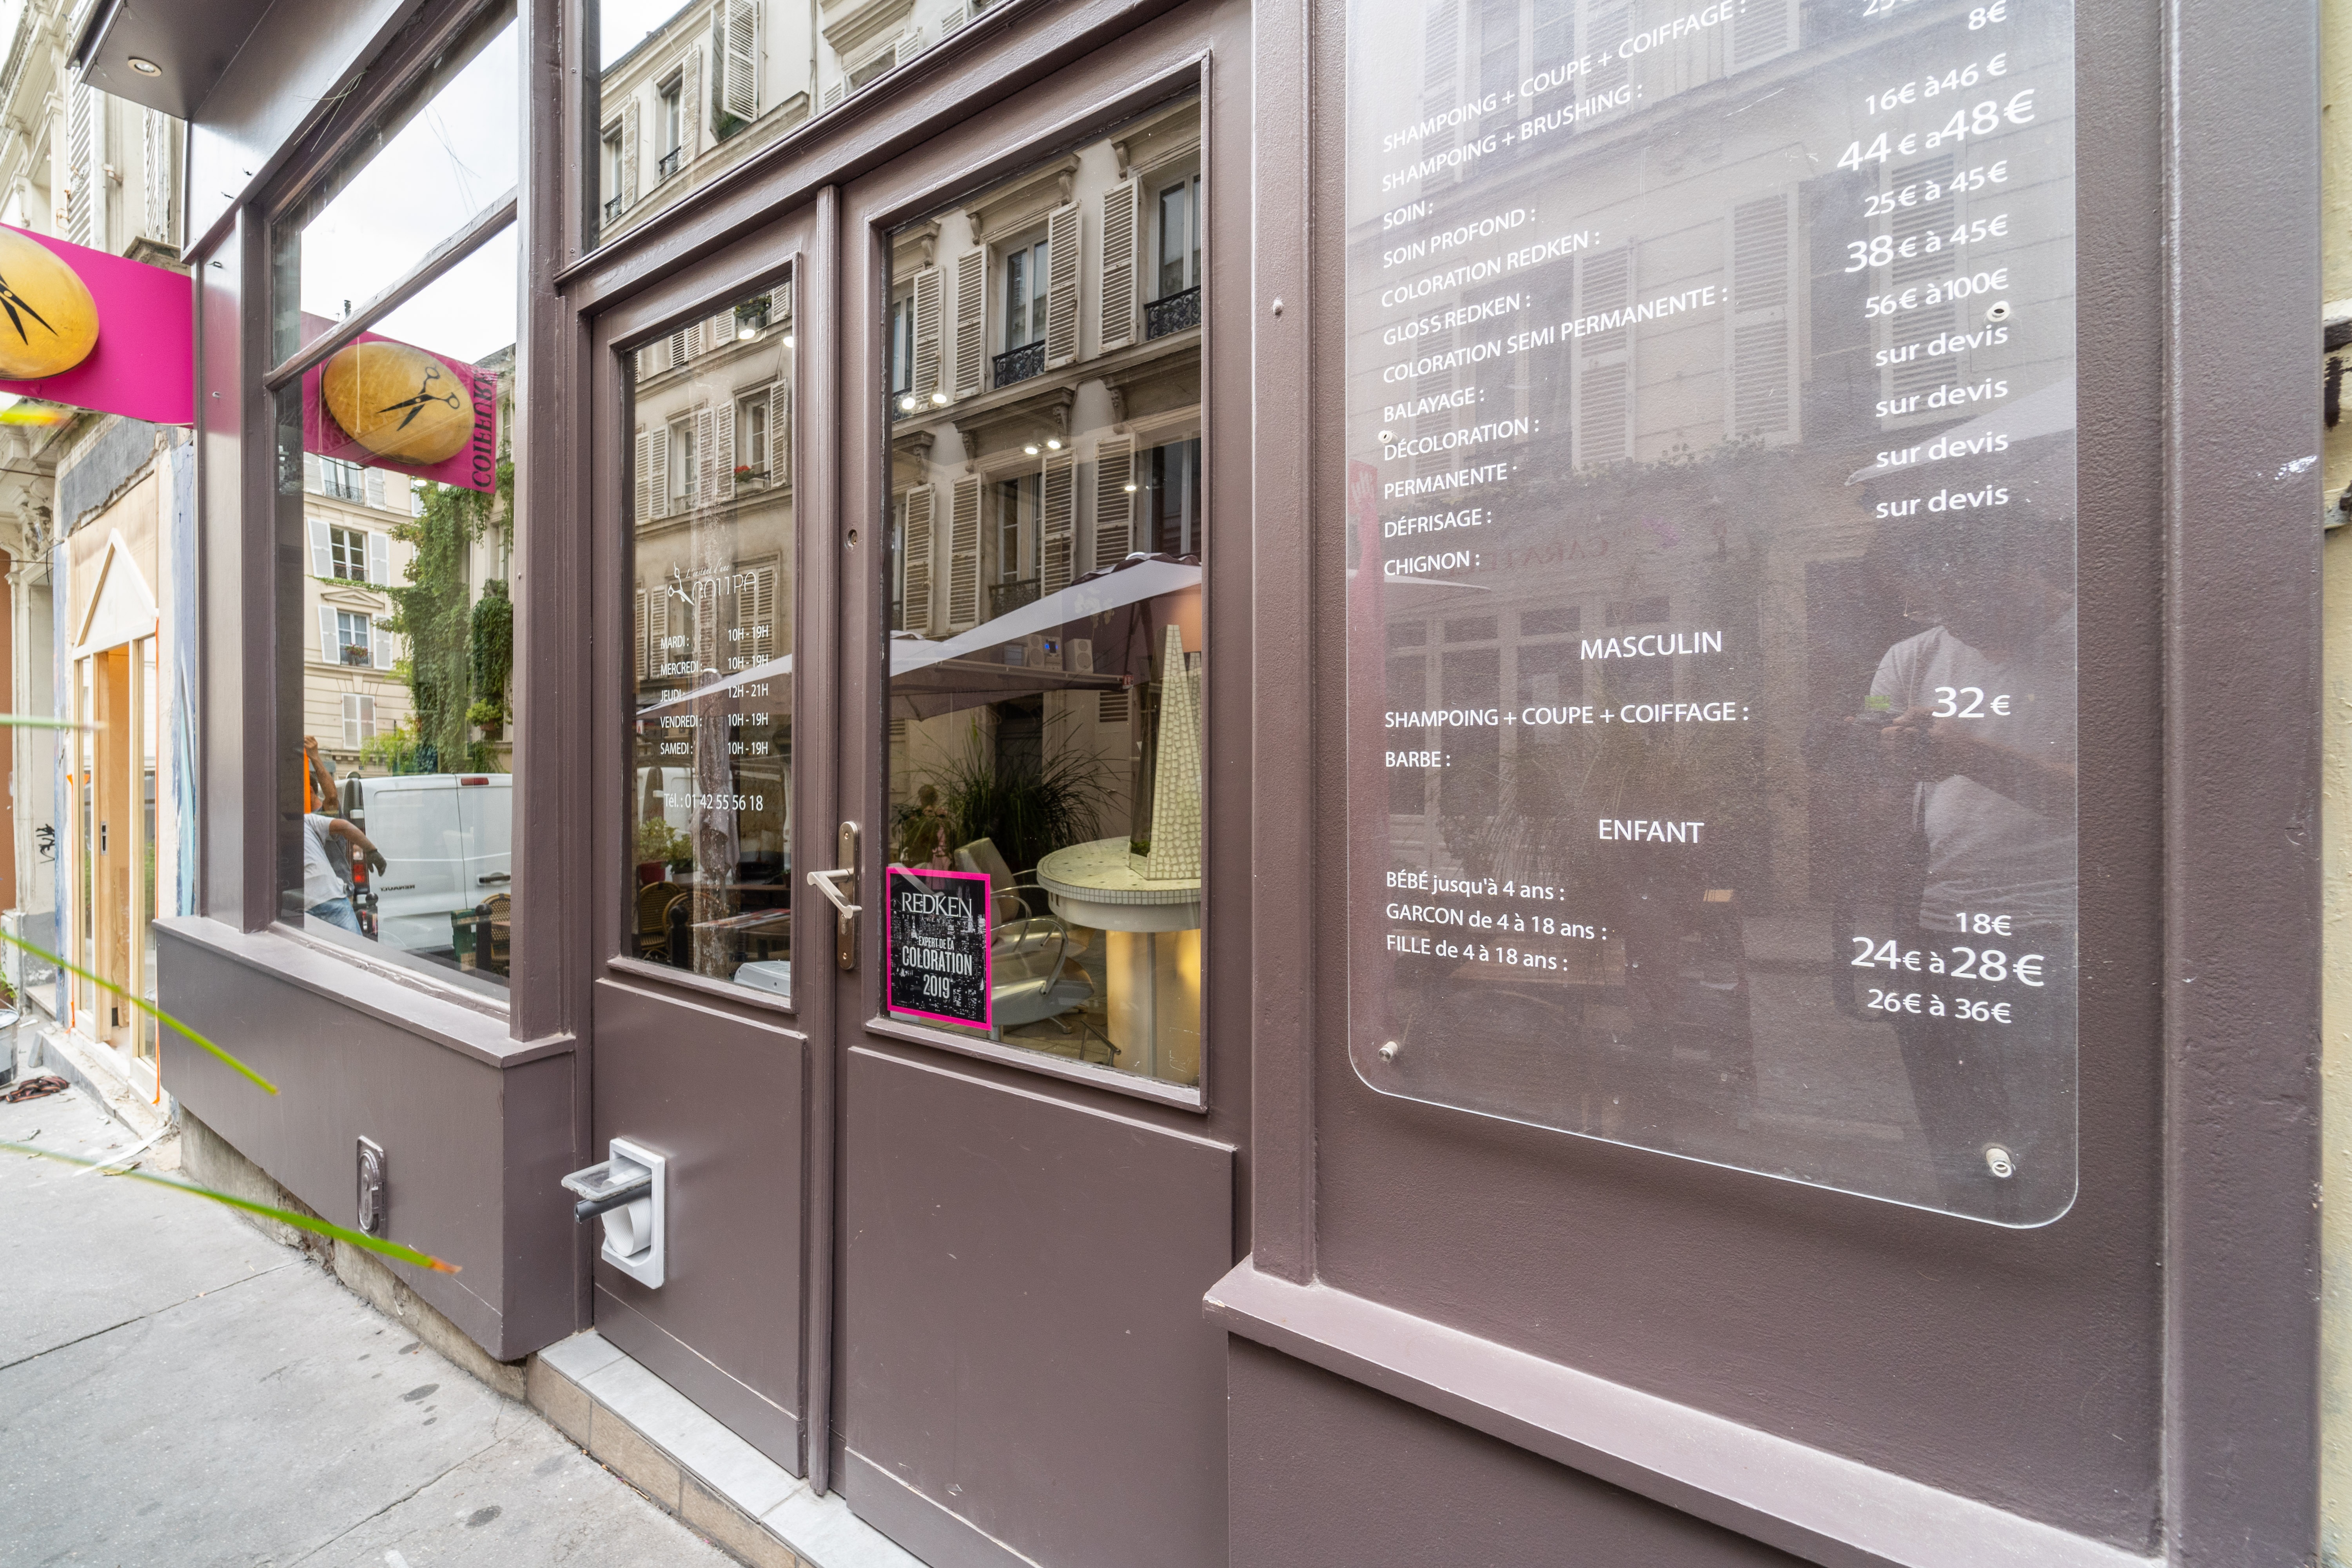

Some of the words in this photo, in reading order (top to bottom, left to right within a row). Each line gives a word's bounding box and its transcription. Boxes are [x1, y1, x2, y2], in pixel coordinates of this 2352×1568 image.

[1968, 0, 2007, 30] 8€
[1383, 93, 1496, 152] SHAMPOING
[1502, 91, 1515, 104] +
[1520, 54, 1592, 97] COUPE
[1597, 52, 1612, 67] +
[1619, 0, 1733, 58] COIFFAGE
[1382, 134, 1496, 192] SHAMPOING
[1501, 132, 1515, 146] +
[1521, 84, 1630, 141] BRUSHING
[1924, 180, 1940, 201] à
[1949, 160, 2008, 192] 45€
[1383, 200, 1425, 230] SOIN
[1383, 240, 1425, 268] SOIN
[1431, 209, 1525, 253] PROFOND
[1925, 230, 1941, 253] à
[1949, 214, 2008, 245] 45€
[1381, 257, 1501, 307] COLORATION
[1507, 230, 1588, 270] REDKEN
[1383, 315, 1441, 345] GLOSS
[1445, 293, 1520, 329] REDKEN
[1383, 339, 1501, 383] COLORATION
[1507, 326, 1554, 354] SEMI
[1561, 285, 1715, 341] PERMANENTE
[1875, 343, 1920, 367] sur
[1927, 325, 2008, 356] devis
[1384, 387, 1475, 422] BALAYAGE
[1875, 395, 1920, 417] sur
[1927, 378, 2008, 408] devis
[1385, 416, 1528, 461] DÉCOLORATION
[1876, 446, 1920, 468] sur
[1928, 431, 2008, 460] devis
[1385, 462, 1507, 499] PERMANENTE
[1875, 498, 1921, 519] sur
[1927, 484, 2010, 512] devis
[1385, 508, 1482, 538] DÉFRISAGE
[1384, 550, 1470, 575] CHIGNON
[661, 635, 685, 649] MARDI
[728, 627, 744, 642] 10H
[751, 625, 768, 639] 19H
[1581, 630, 1722, 660] MASCULIN
[661, 661, 699, 676] MERCREDI
[728, 656, 744, 670] 10H
[751, 654, 768, 668] 19H
[661, 689, 681, 702] JEUDI
[728, 685, 744, 698] 12H
[751, 683, 768, 697] 21H
[660, 715, 697, 728] VENDREDI
[728, 713, 744, 726] 10H
[752, 712, 768, 726] 19H
[1385, 709, 1498, 728] SHAMPOING
[1503, 711, 1517, 725] +
[1522, 706, 1594, 725] COUPE
[1600, 709, 1615, 723] +
[1620, 702, 1736, 723] COIFFAGE
[661, 742, 689, 755] SAMEDI
[728, 742, 743, 755] 10H
[751, 741, 768, 755] 19H
[1385, 750, 1441, 768] BARBE
[664, 793, 679, 807] Tél.
[685, 794, 696, 808] 01
[700, 794, 713, 809] 42
[716, 794, 730, 810] 55
[732, 795, 746, 810] 56
[750, 795, 763, 811] 18
[1599, 818, 1705, 844] ENFANT
[1387, 869, 1428, 890] BÉBÉ
[1431, 878, 1498, 898] jusqu'à
[1503, 880, 1515, 897] 4
[1520, 885, 1554, 900] ans
[902, 892, 972, 918] REDKEN
[1386, 903, 1463, 926] GARCON
[1468, 910, 1492, 929] de
[1497, 914, 1509, 930] 4
[1514, 913, 1524, 932] à
[1532, 916, 1555, 935] 18
[1560, 923, 1595, 940] ans
[1956, 912, 2013, 936] 18€
[918, 936, 938, 947] EXPERT
[939, 938, 946, 949] DE
[947, 939, 954, 950] LA
[1387, 934, 1431, 955] FILLE
[1435, 940, 1458, 958] de
[1463, 944, 1475, 960] 4
[1479, 944, 1489, 962] à
[1496, 947, 1518, 965] 18
[1523, 953, 1557, 970] ans
[902, 945, 972, 976] COLORATION
[1929, 951, 1946, 975] à
[923, 974, 950, 999] 2019
[1867, 989, 1922, 1014] 26€
[1929, 994, 1946, 1017] à
[1955, 998, 2012, 1024] 36€
